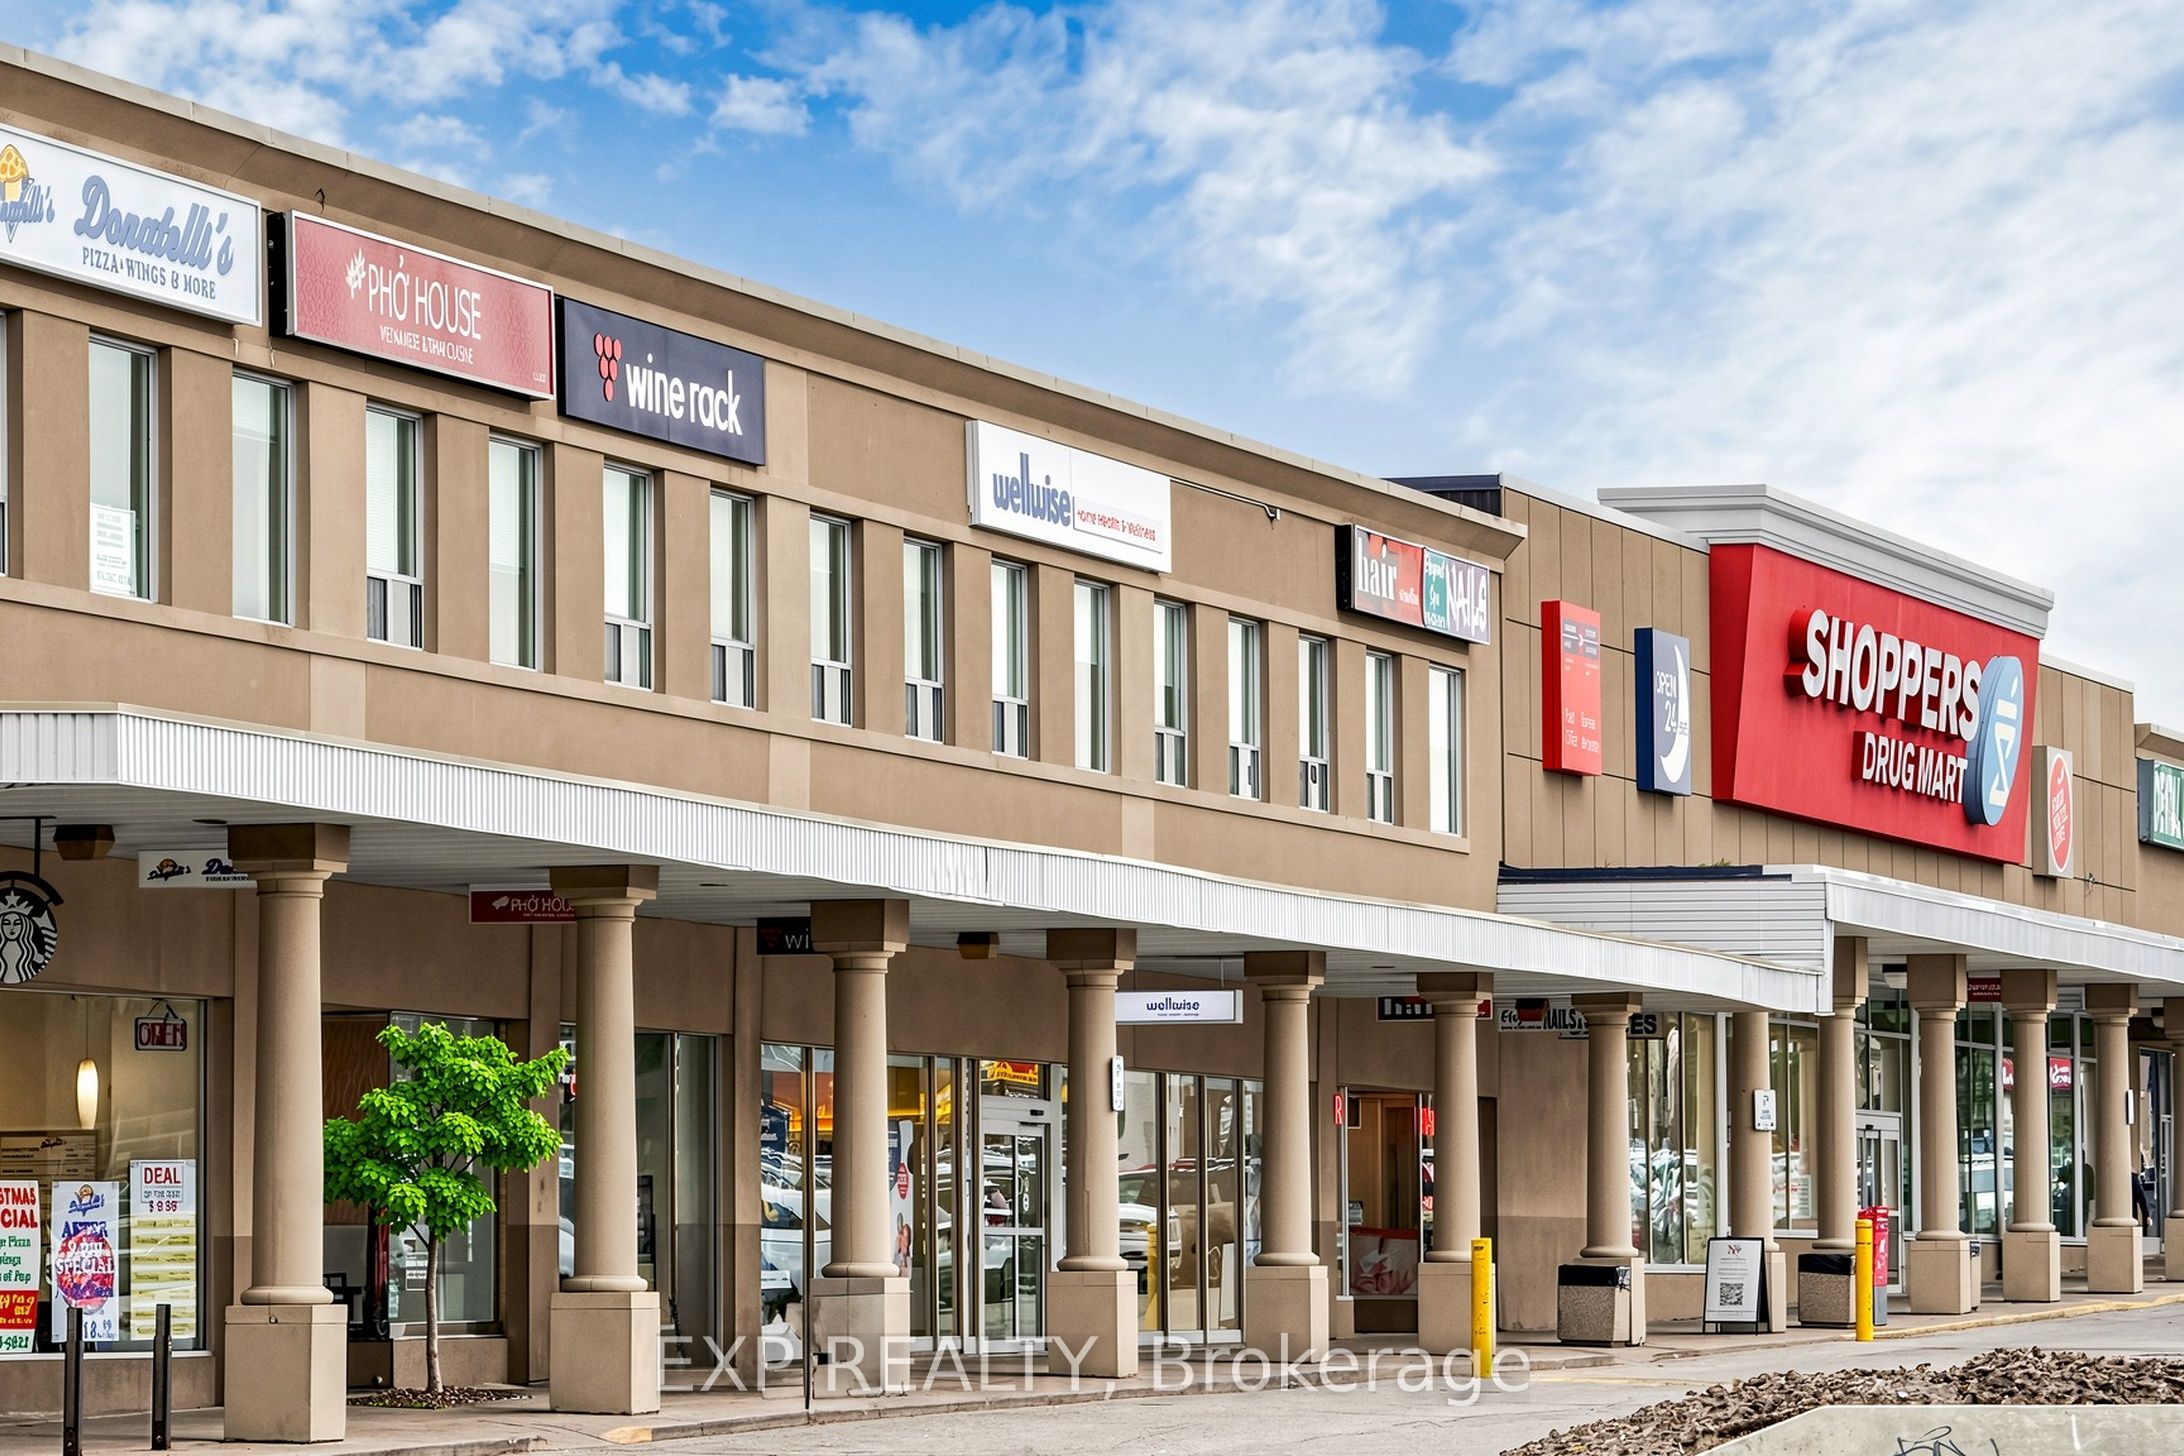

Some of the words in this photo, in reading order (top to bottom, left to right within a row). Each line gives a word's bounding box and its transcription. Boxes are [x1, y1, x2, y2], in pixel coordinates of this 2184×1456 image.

[74, 174, 234, 277] Donatelli's
[183, 274, 217, 300] MORE
[415, 276, 482, 341] HOUSE
[625, 353, 686, 420] wine
[689, 370, 743, 436] rack
[992, 452, 1071, 527] wellwise
[1357, 537, 1398, 601] hair
[1802, 609, 1984, 742] SHOPPERS
[1862, 731, 1916, 790] DRUG
[1916, 746, 1969, 804] MART
[785, 928, 809, 950] wi
[144, 1167, 181, 1184] DEAL
